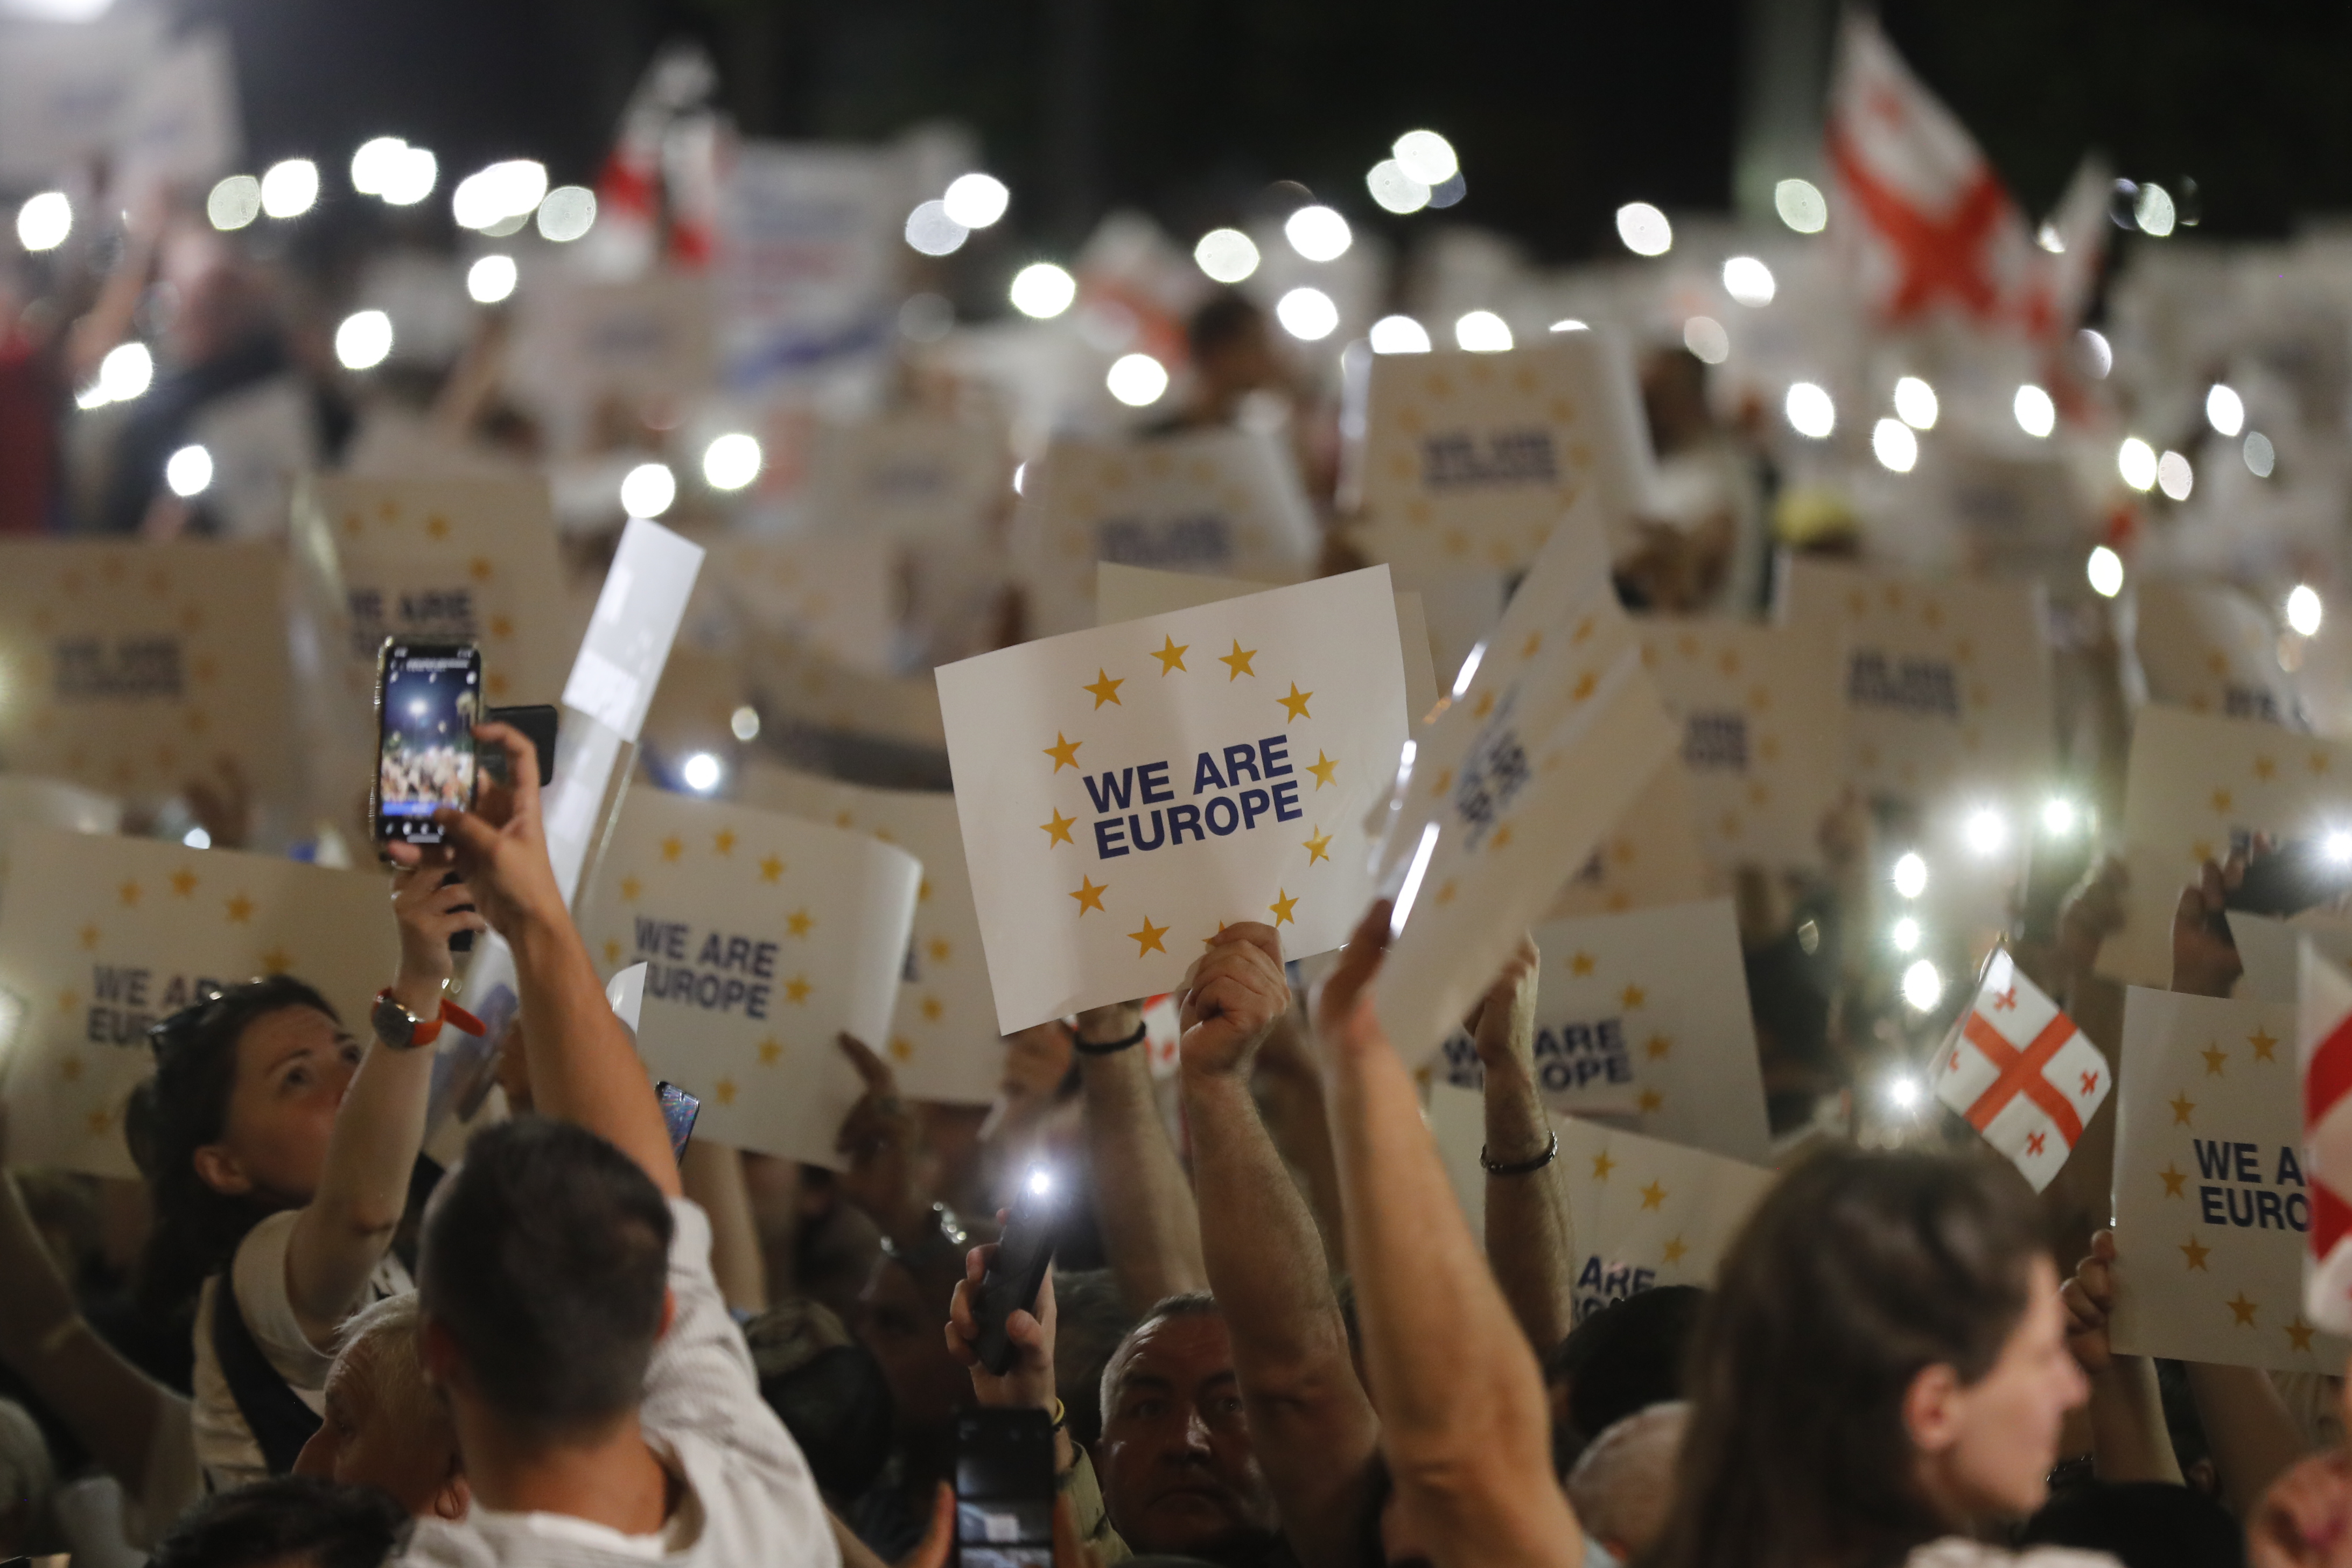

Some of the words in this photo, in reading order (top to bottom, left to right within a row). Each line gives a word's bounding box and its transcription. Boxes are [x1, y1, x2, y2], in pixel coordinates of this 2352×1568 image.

[1082, 760, 1174, 814] WE
[1193, 734, 1293, 795] ARE
[1094, 780, 1303, 860] EUROPE
[634, 915, 689, 960] WE
[699, 933, 779, 978] ARE
[93, 965, 150, 1005] WE
[163, 975, 222, 1006] AR
[631, 957, 771, 1019] UROPE
[1534, 1019, 1626, 1058] ARE
[2193, 1138, 2262, 1184] WE
[2200, 1186, 2312, 1233] EURO
